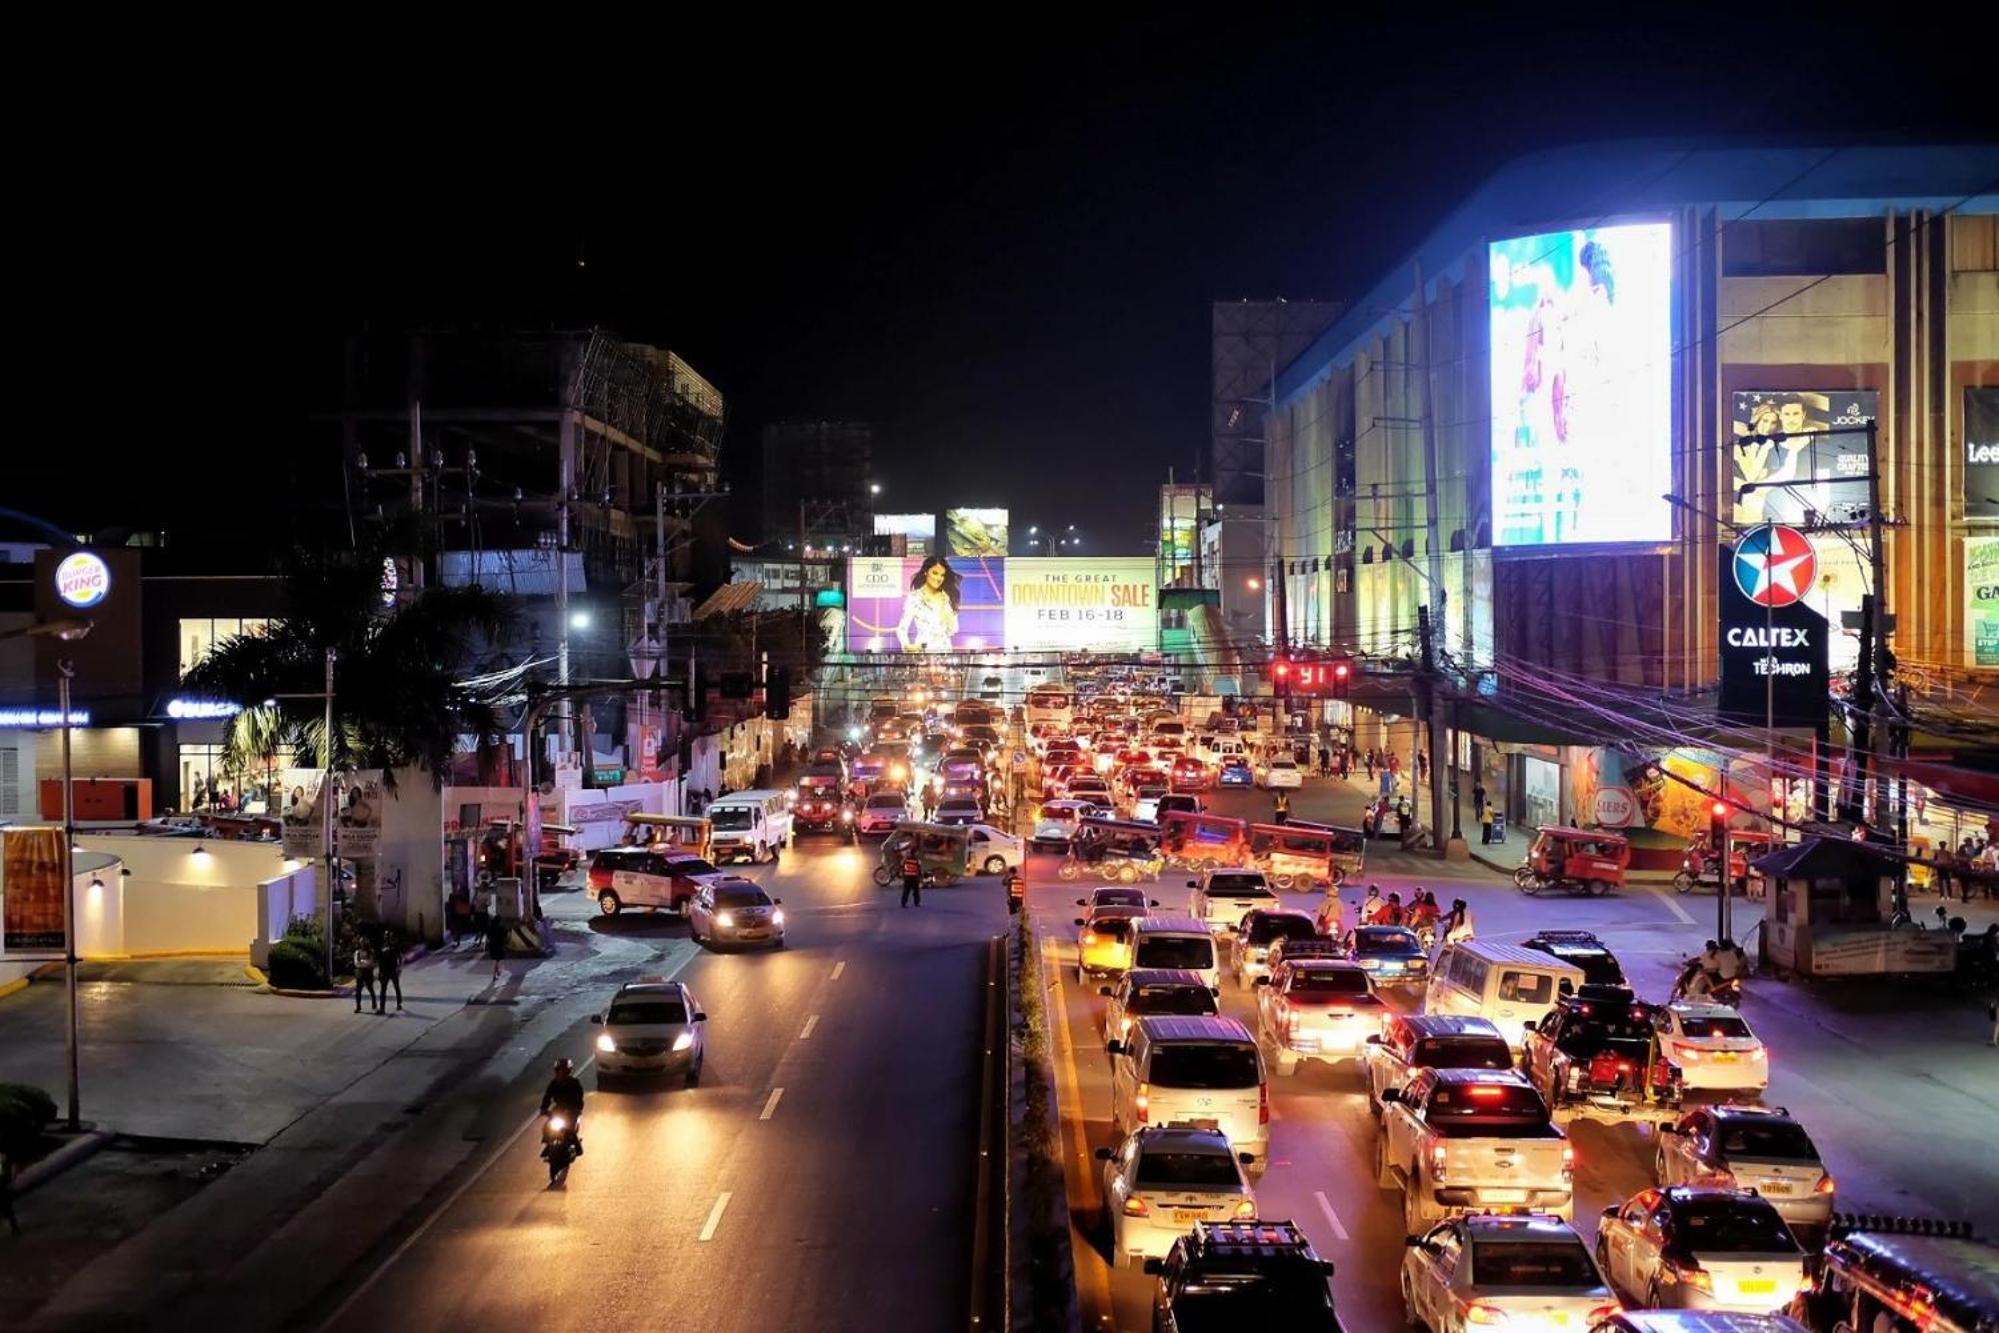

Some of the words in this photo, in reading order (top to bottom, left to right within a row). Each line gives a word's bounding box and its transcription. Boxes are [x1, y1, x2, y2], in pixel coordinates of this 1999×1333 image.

[1968, 443, 1999, 463] Lee
[63, 574, 102, 593] KING
[866, 574, 888, 583] CDO
[1045, 574, 1068, 583] THE
[1074, 574, 1117, 583] GREAT
[1012, 583, 1105, 607] DOWNTOWN
[1111, 584, 1150, 607] SALE
[1037, 609, 1070, 621] FEB
[1077, 609, 1124, 621] 16-18
[1727, 627, 1810, 647] CALTEX
[1753, 661, 1811, 677] TECHRON
